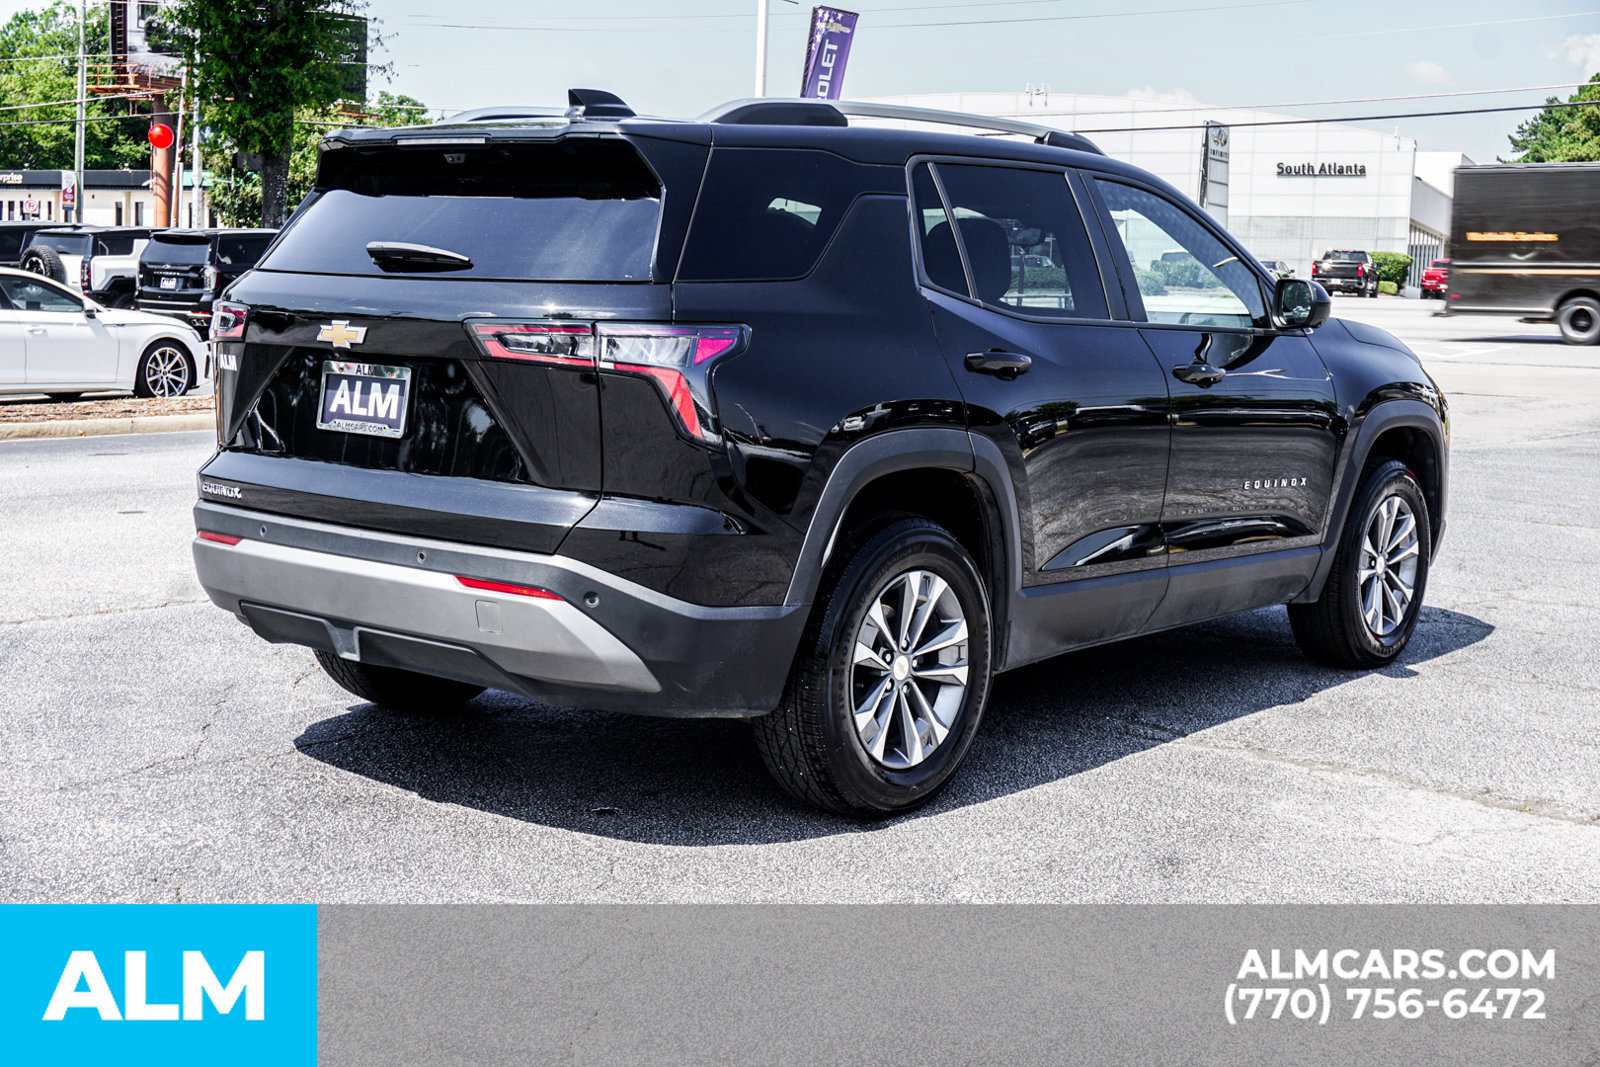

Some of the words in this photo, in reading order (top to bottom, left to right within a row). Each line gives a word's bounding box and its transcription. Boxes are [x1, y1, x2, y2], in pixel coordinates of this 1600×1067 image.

[817, 39, 839, 99] OLET
[1276, 162, 1315, 175] South
[1318, 162, 1366, 175] Atlanta
[220, 353, 238, 372] ALM
[355, 364, 377, 376] ALM
[329, 379, 400, 420] ALM
[1243, 476, 1307, 490] EQUINOX
